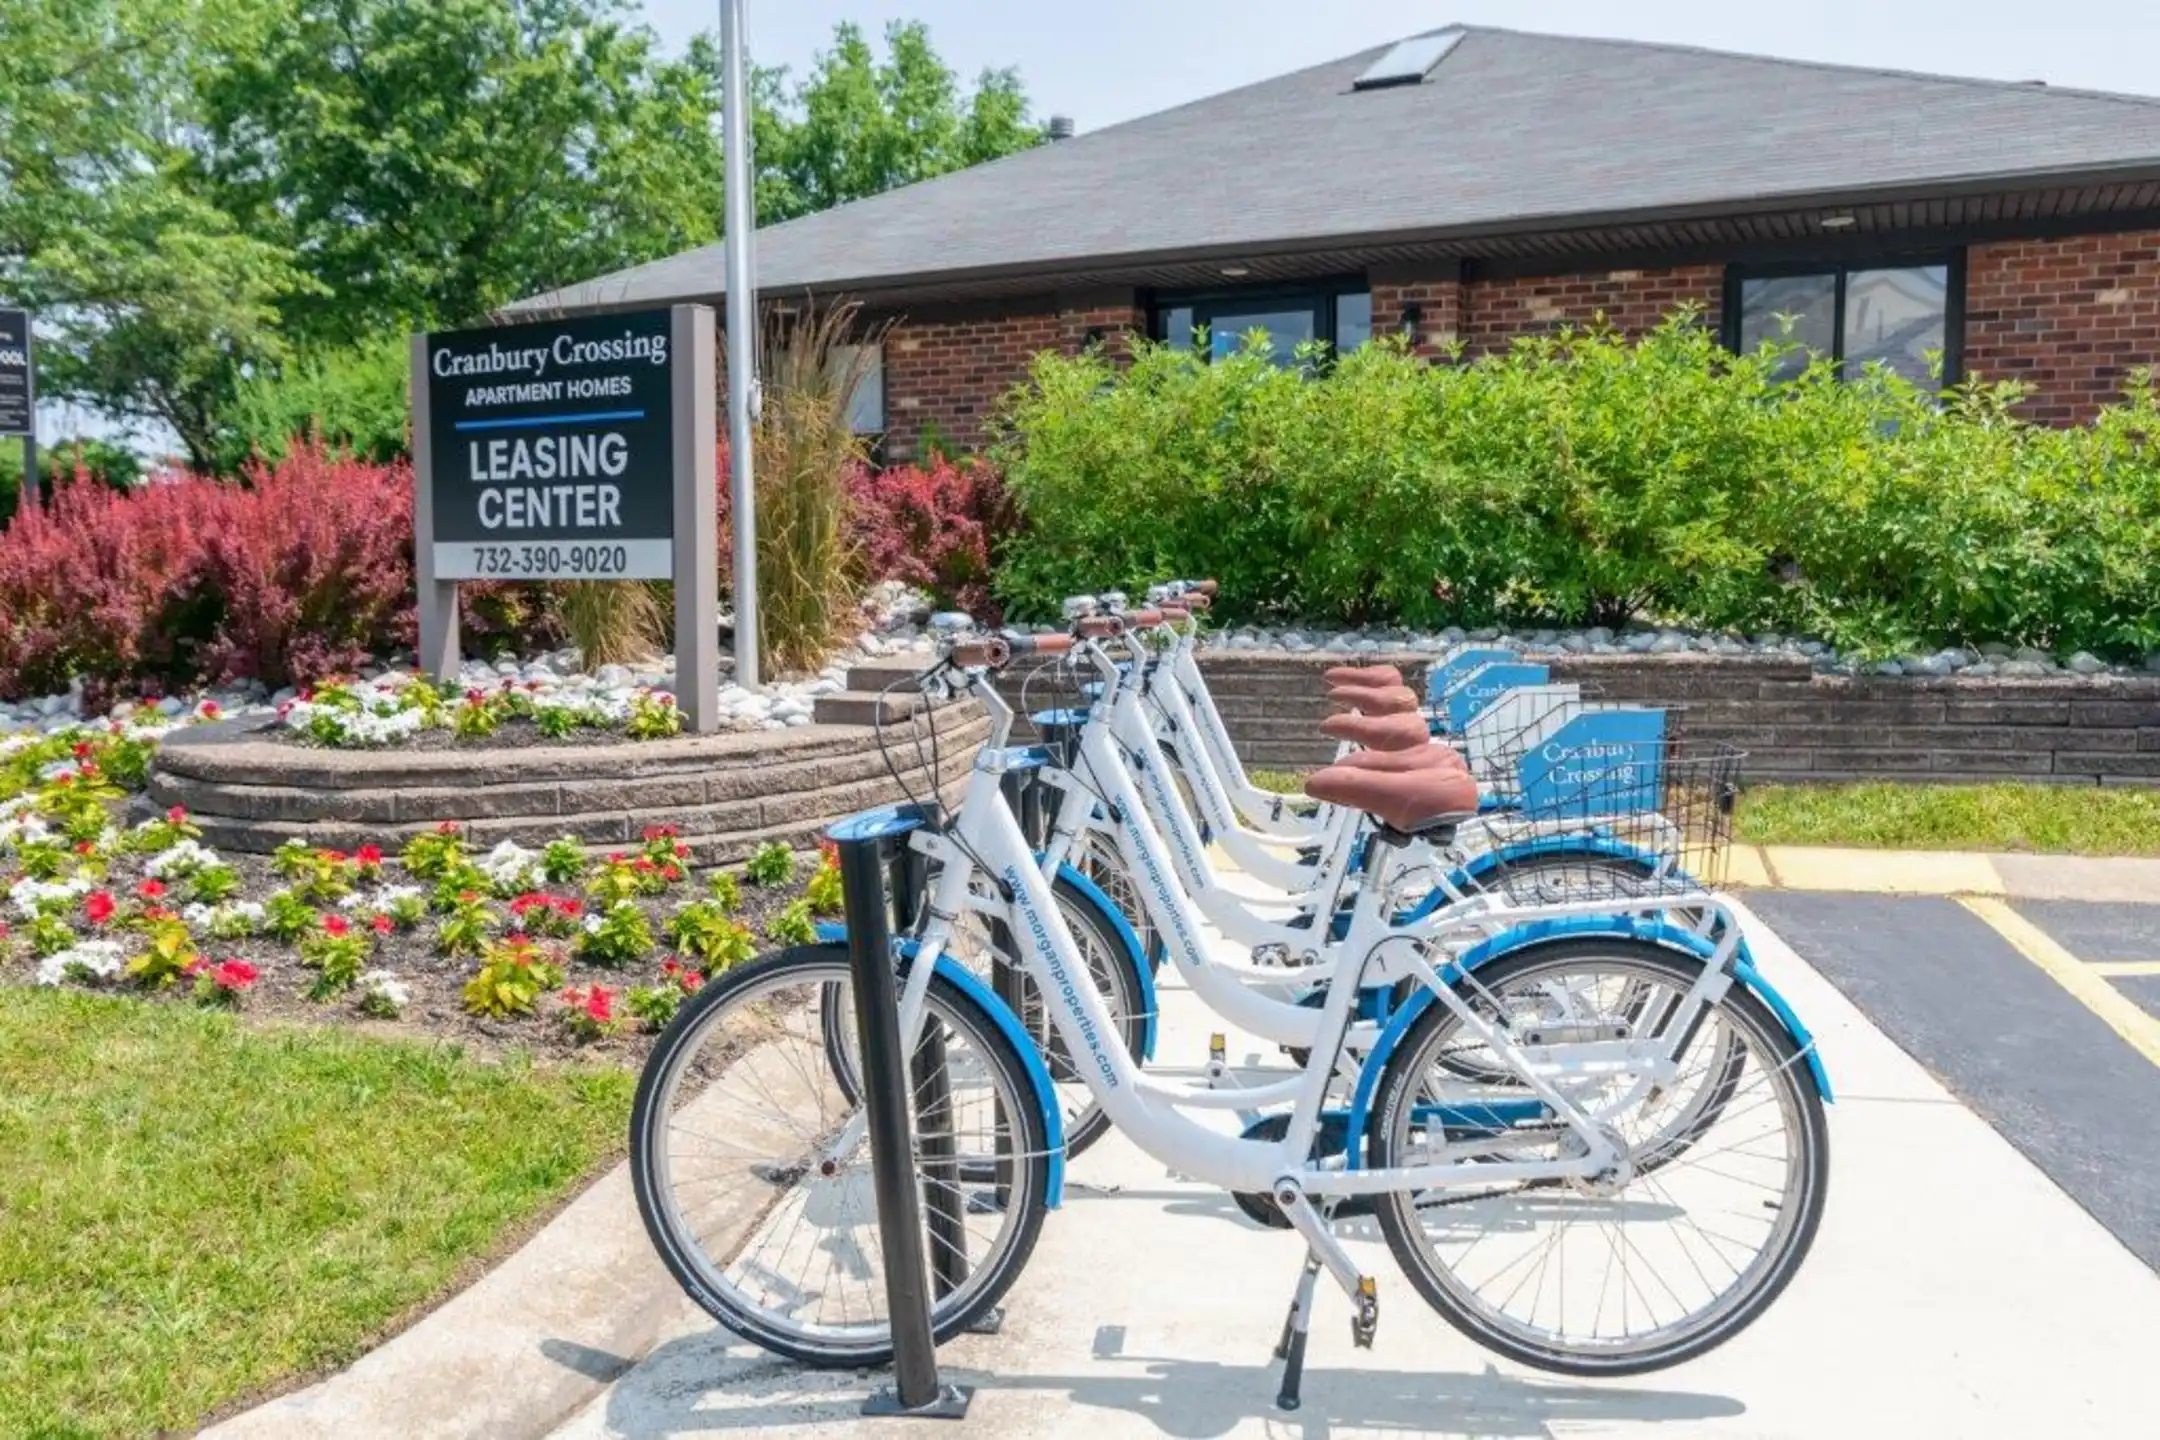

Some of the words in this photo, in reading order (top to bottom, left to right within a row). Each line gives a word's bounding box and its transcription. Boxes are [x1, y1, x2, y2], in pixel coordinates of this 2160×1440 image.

[433, 342, 548, 377] Cranbury
[552, 331, 667, 364] Crossing
[464, 382, 563, 407] APARTMENT
[566, 376, 632, 399] HOMES
[469, 432, 628, 481] LEASING
[477, 484, 622, 528] CENTER
[474, 545, 627, 573] 732-390-9020
[1115, 794, 1200, 966] www.morganproperties.com
[1003, 864, 1119, 1088] www.morganproperties.com
